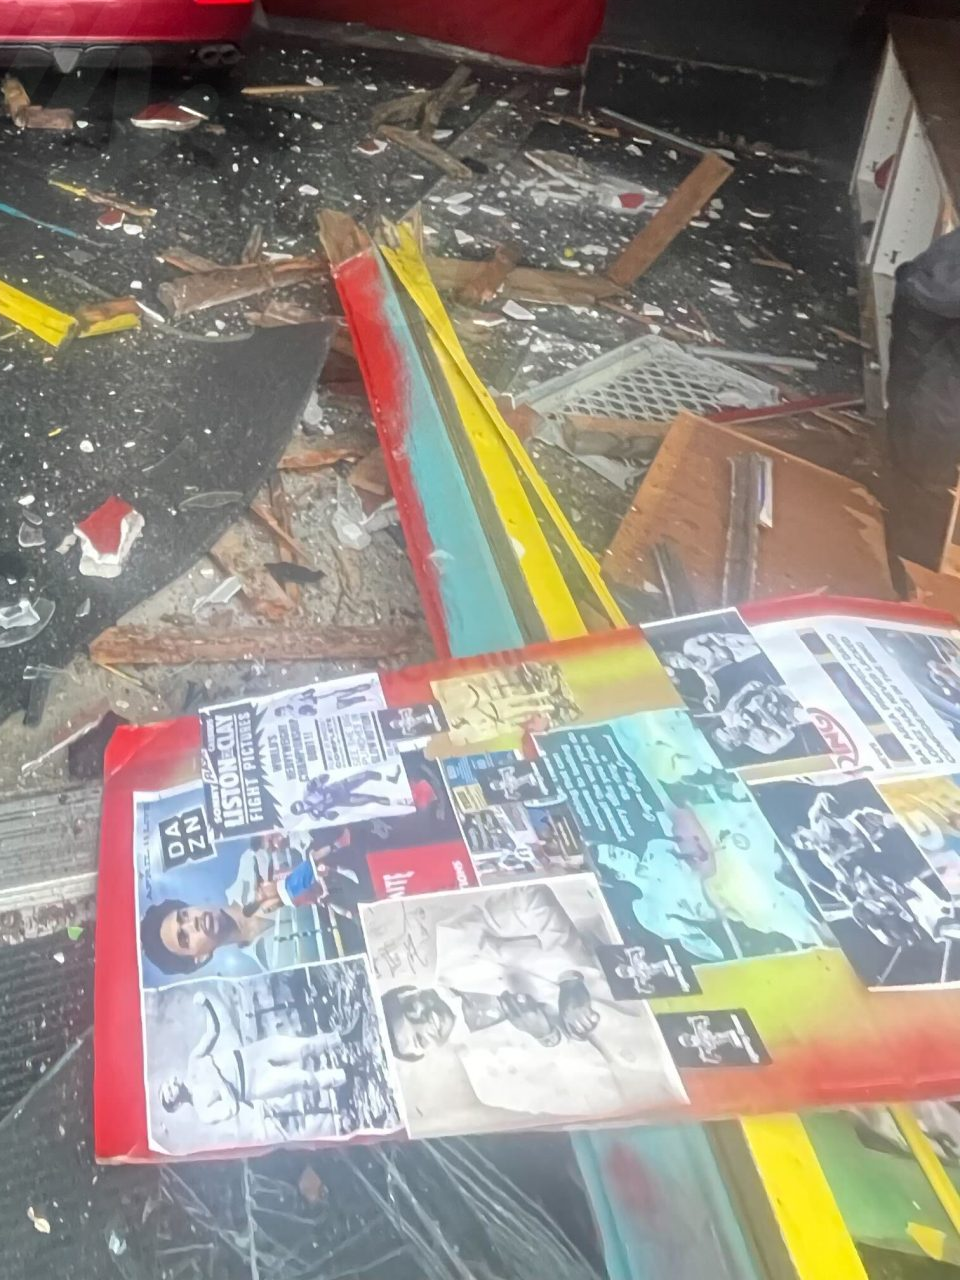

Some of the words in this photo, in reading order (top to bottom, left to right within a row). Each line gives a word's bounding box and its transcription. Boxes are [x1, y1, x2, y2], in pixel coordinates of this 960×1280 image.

[214, 713, 235, 750] CLAY
[237, 711, 256, 770] PICTURES
[217, 757, 244, 827] LISTON
[245, 776, 263, 822] FIGHT
